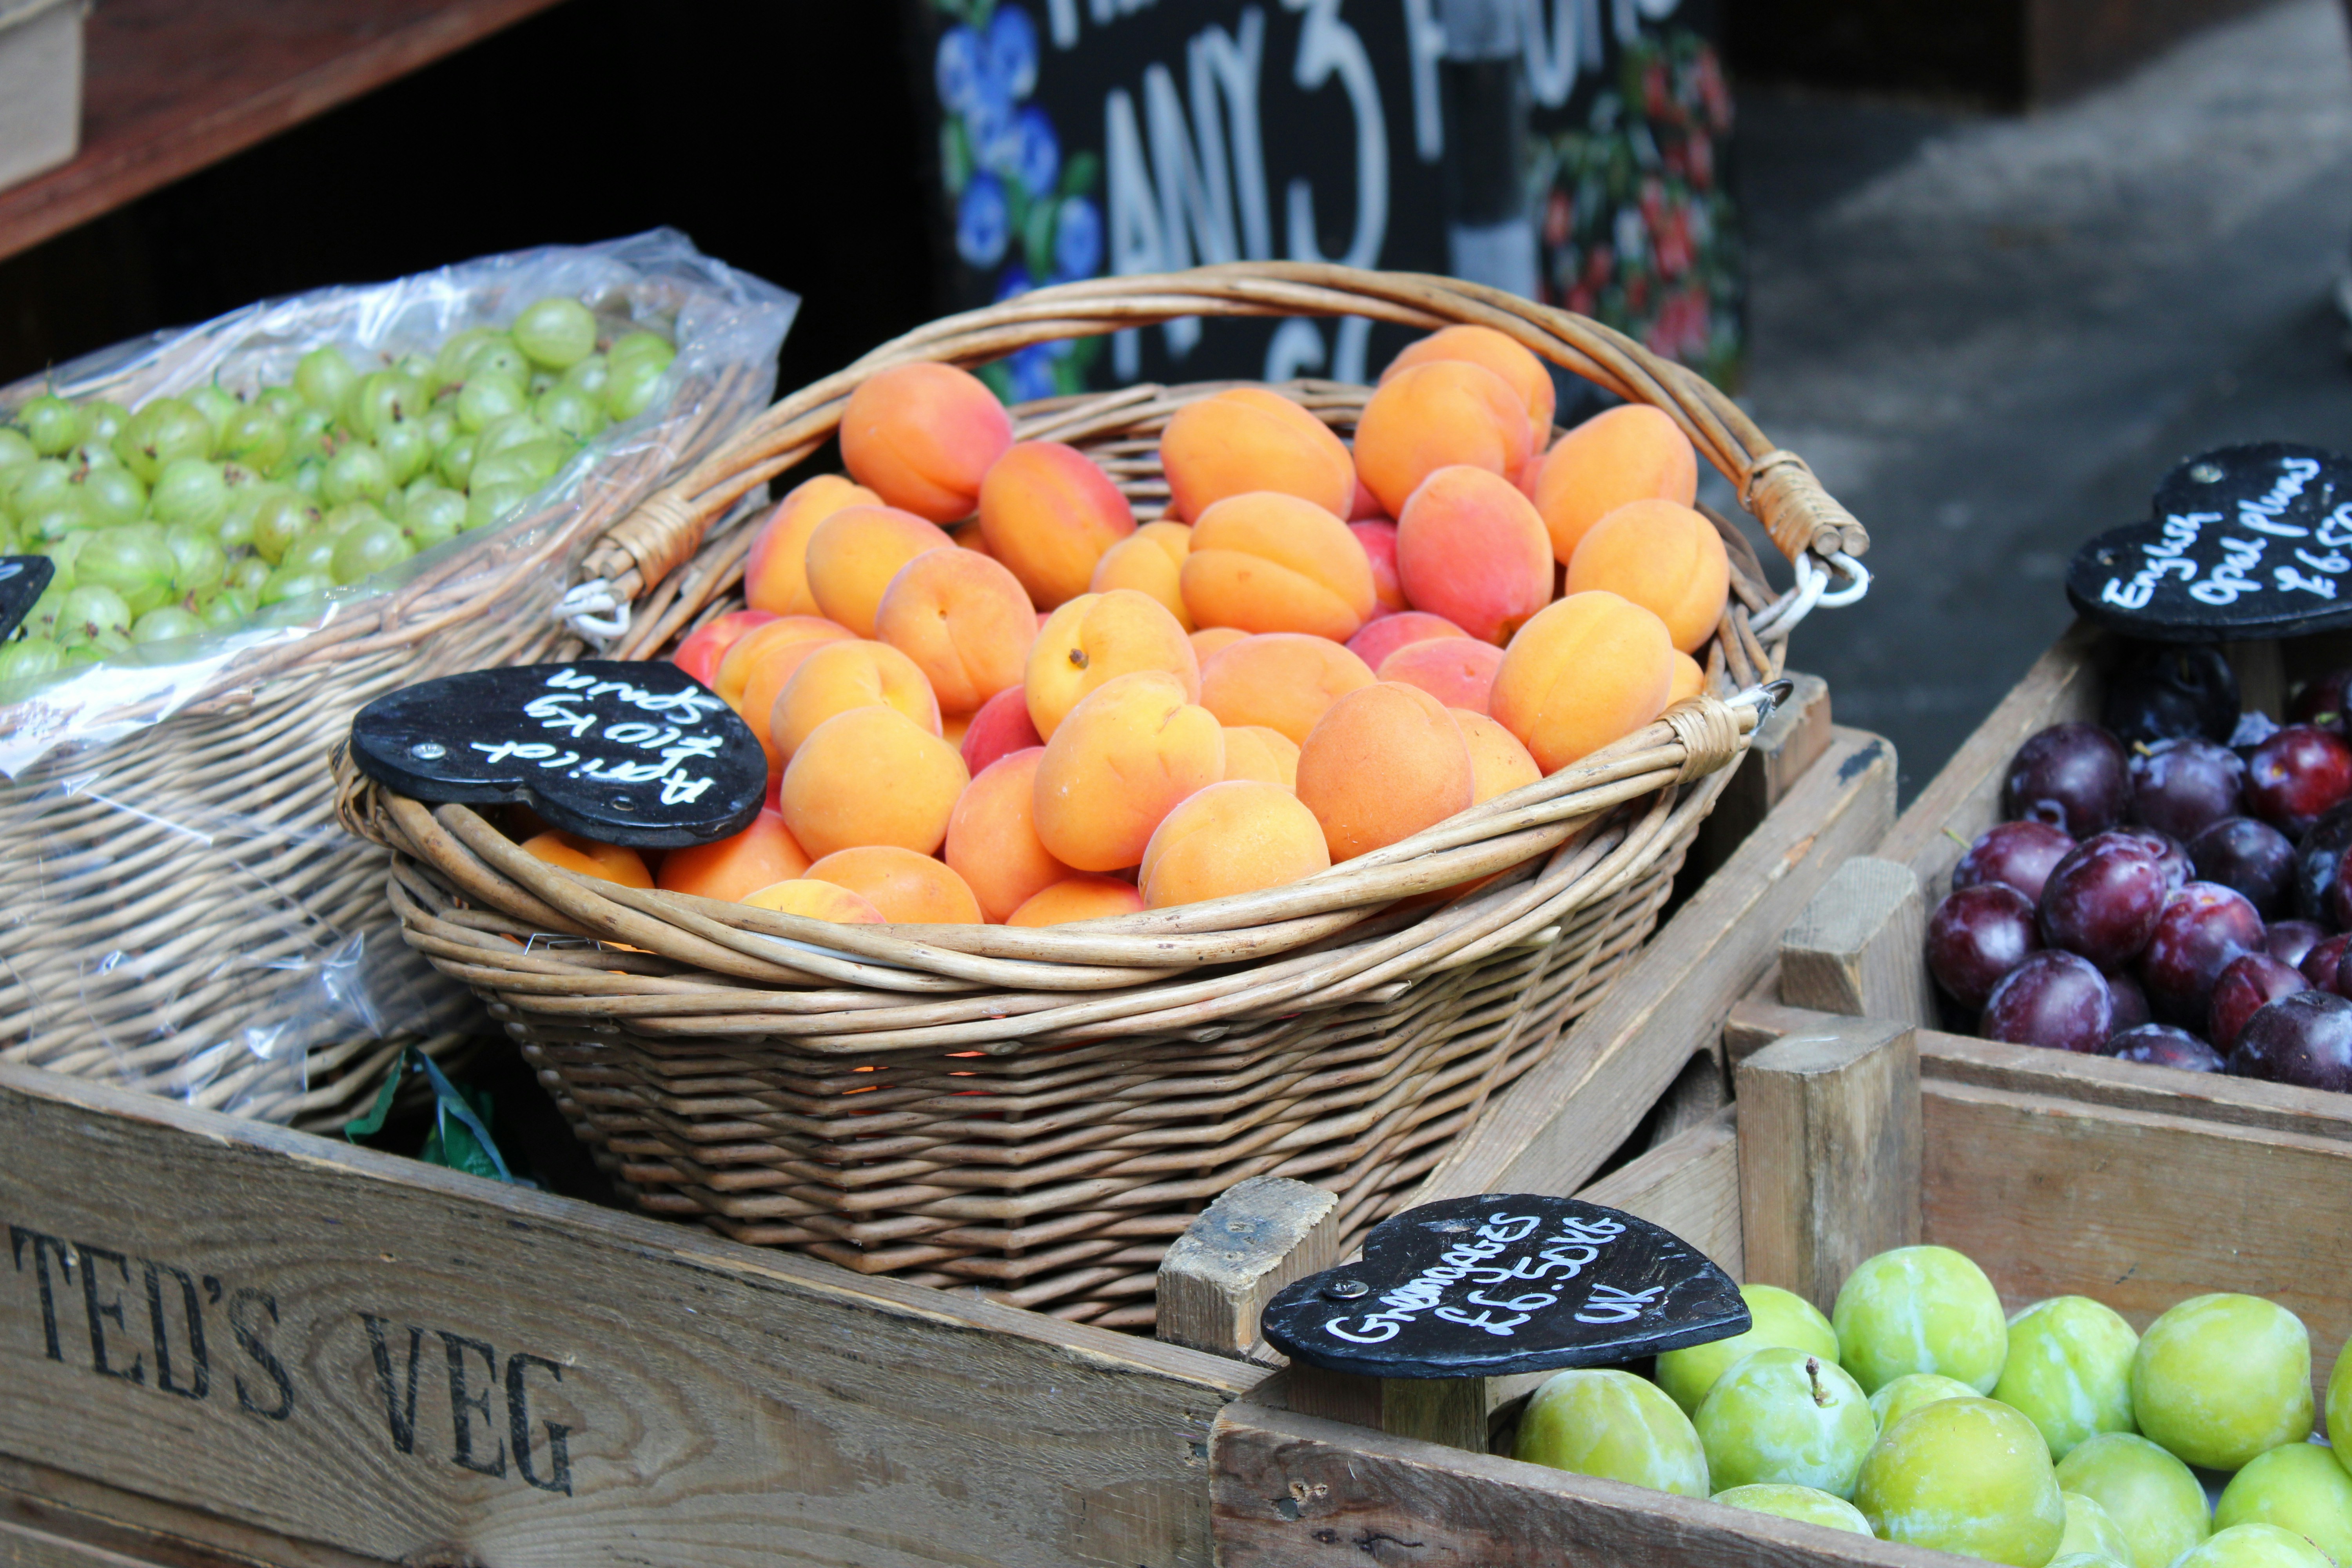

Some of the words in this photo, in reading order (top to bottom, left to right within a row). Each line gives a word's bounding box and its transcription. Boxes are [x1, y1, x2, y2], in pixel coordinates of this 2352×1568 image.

[1103, 3, 1272, 382] ANY
[2102, 512, 2223, 609] English
[546, 668, 720, 724] Spain
[604, 722, 723, 758] £10
[470, 741, 716, 805] Apricot
[1574, 1283, 1665, 1323] UK
[9, 1224, 294, 1422] TED'S
[356, 1311, 573, 1497] VEG
